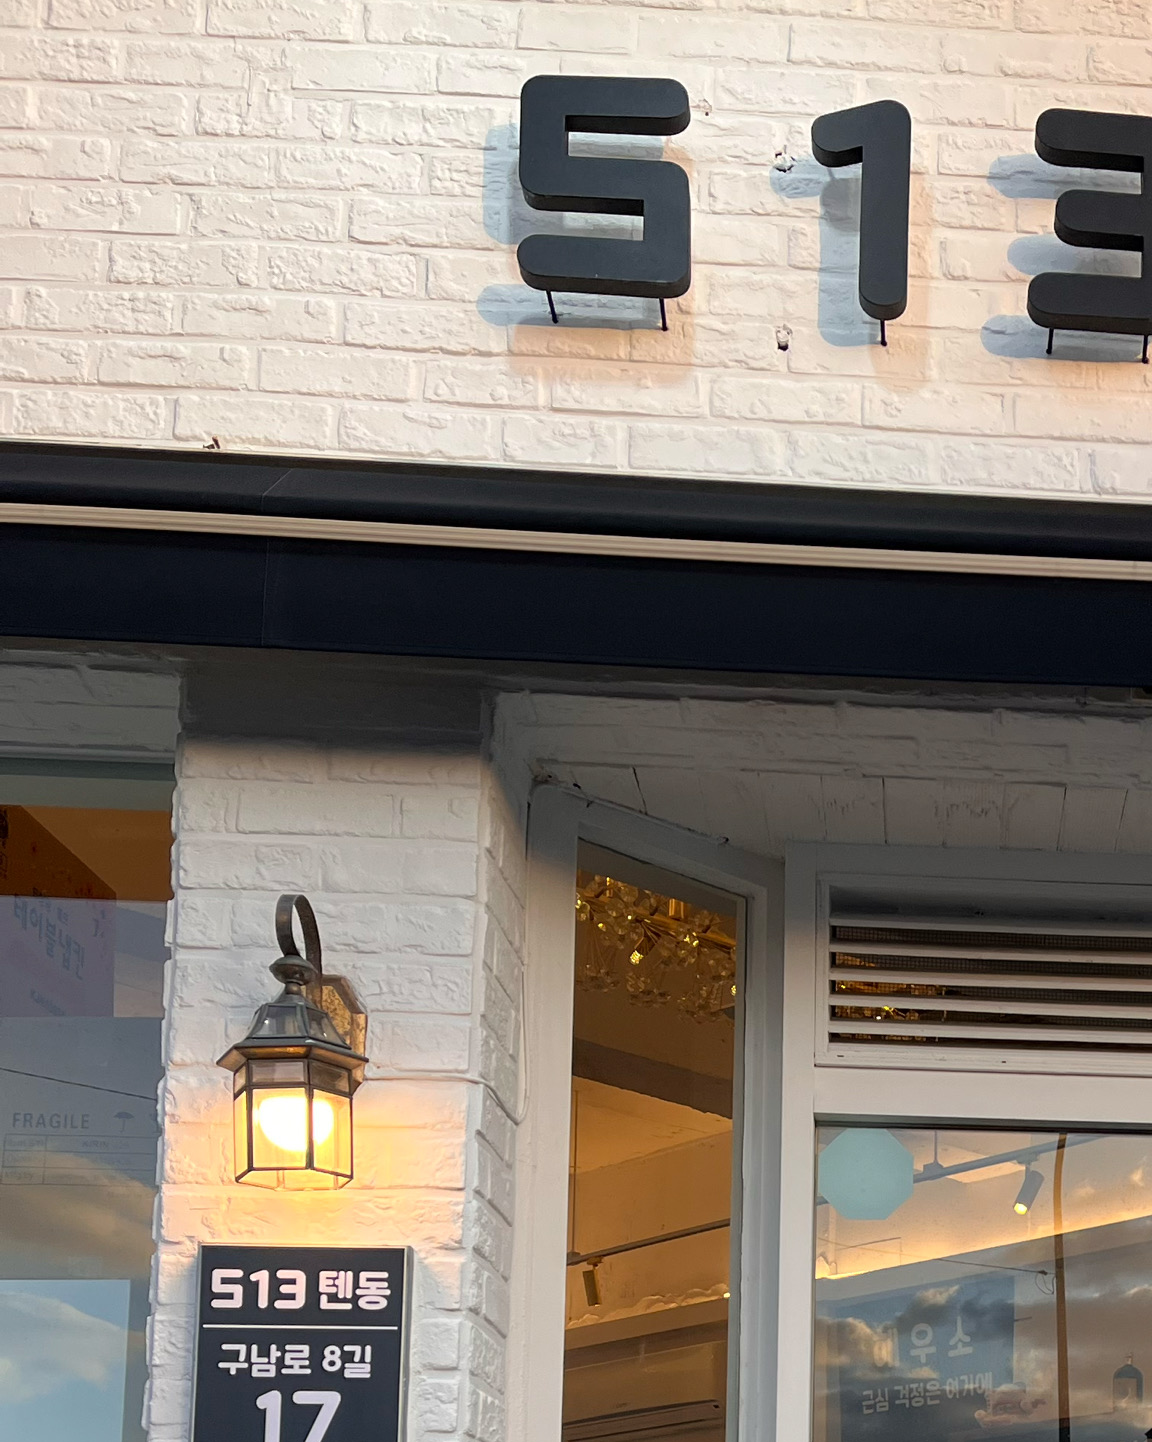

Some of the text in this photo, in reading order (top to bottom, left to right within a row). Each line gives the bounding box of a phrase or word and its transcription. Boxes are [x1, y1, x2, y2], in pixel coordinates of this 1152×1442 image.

[12, 1112, 90, 1129] FRAGILE
[211, 1269, 391, 1310] 513 텐동
[218, 1343, 371, 1378] 구남로 8길
[862, 1388, 889, 1414] 근심
[894, 1381, 941, 1408] 걱정은
